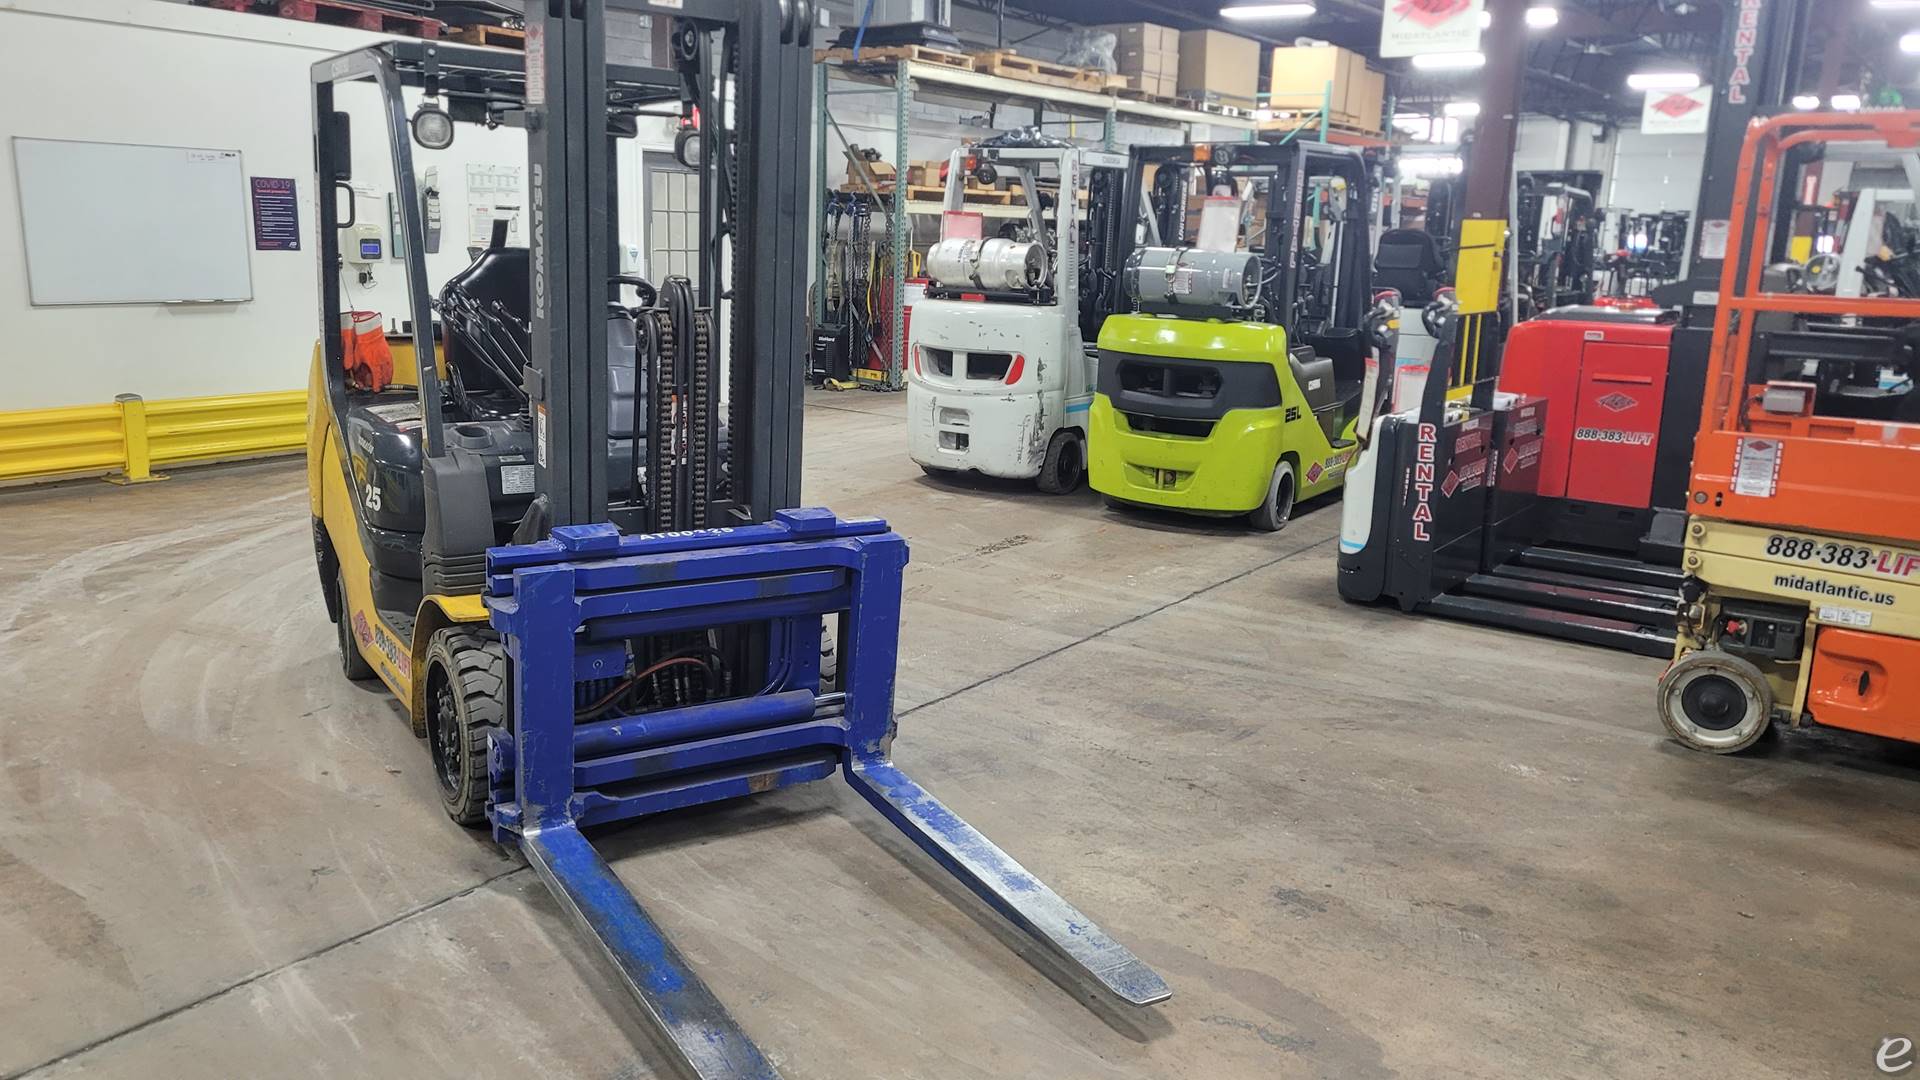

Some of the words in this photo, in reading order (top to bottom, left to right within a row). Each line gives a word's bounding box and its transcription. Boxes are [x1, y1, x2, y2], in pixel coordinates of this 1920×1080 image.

[255, 180, 291, 189] COVID-19
[1069, 159, 1078, 244] RENTAL
[533, 163, 545, 320] KOMATSU
[365, 483, 382, 512] 25
[1412, 423, 1437, 541] RENTAL
[1774, 574, 1896, 606] midatlantic.us
